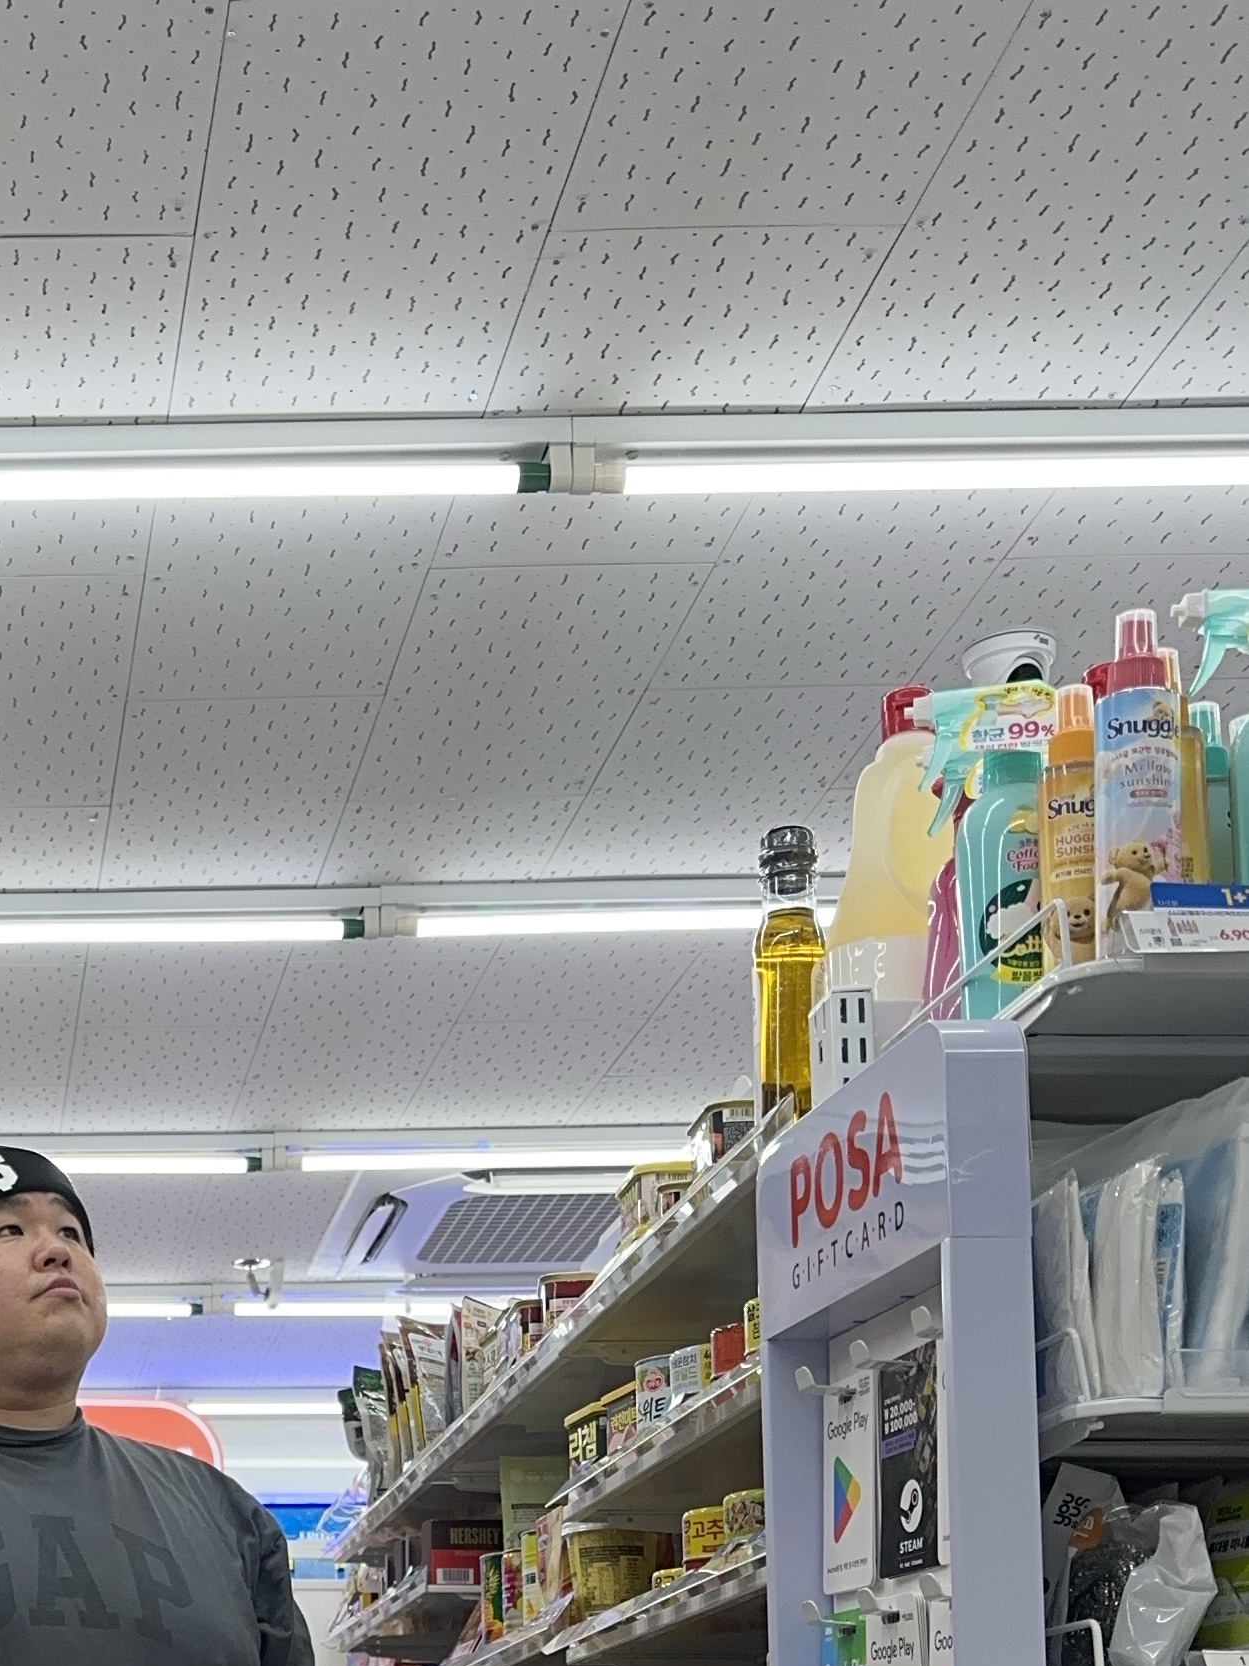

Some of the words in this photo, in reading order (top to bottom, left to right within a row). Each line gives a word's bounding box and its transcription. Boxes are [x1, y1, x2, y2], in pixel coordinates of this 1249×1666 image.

[1008, 720, 1056, 740] 99%
[1107, 716, 1180, 741] Snuggle
[1123, 763, 1172, 775] Mellow
[1119, 773, 1173, 790] sunshin
[1047, 799, 1094, 820] Snug
[1012, 861, 1040, 874] Foo
[790, 1091, 904, 1249] POSA
[827, 1416, 853, 1440] Google
[853, 1411, 870, 1432] Play
[569, 1420, 597, 1463] 리챔
[899, 1541, 924, 1554] STEAM
[870, 1640, 898, 1664] Google
[899, 1637, 915, 1661] Play
